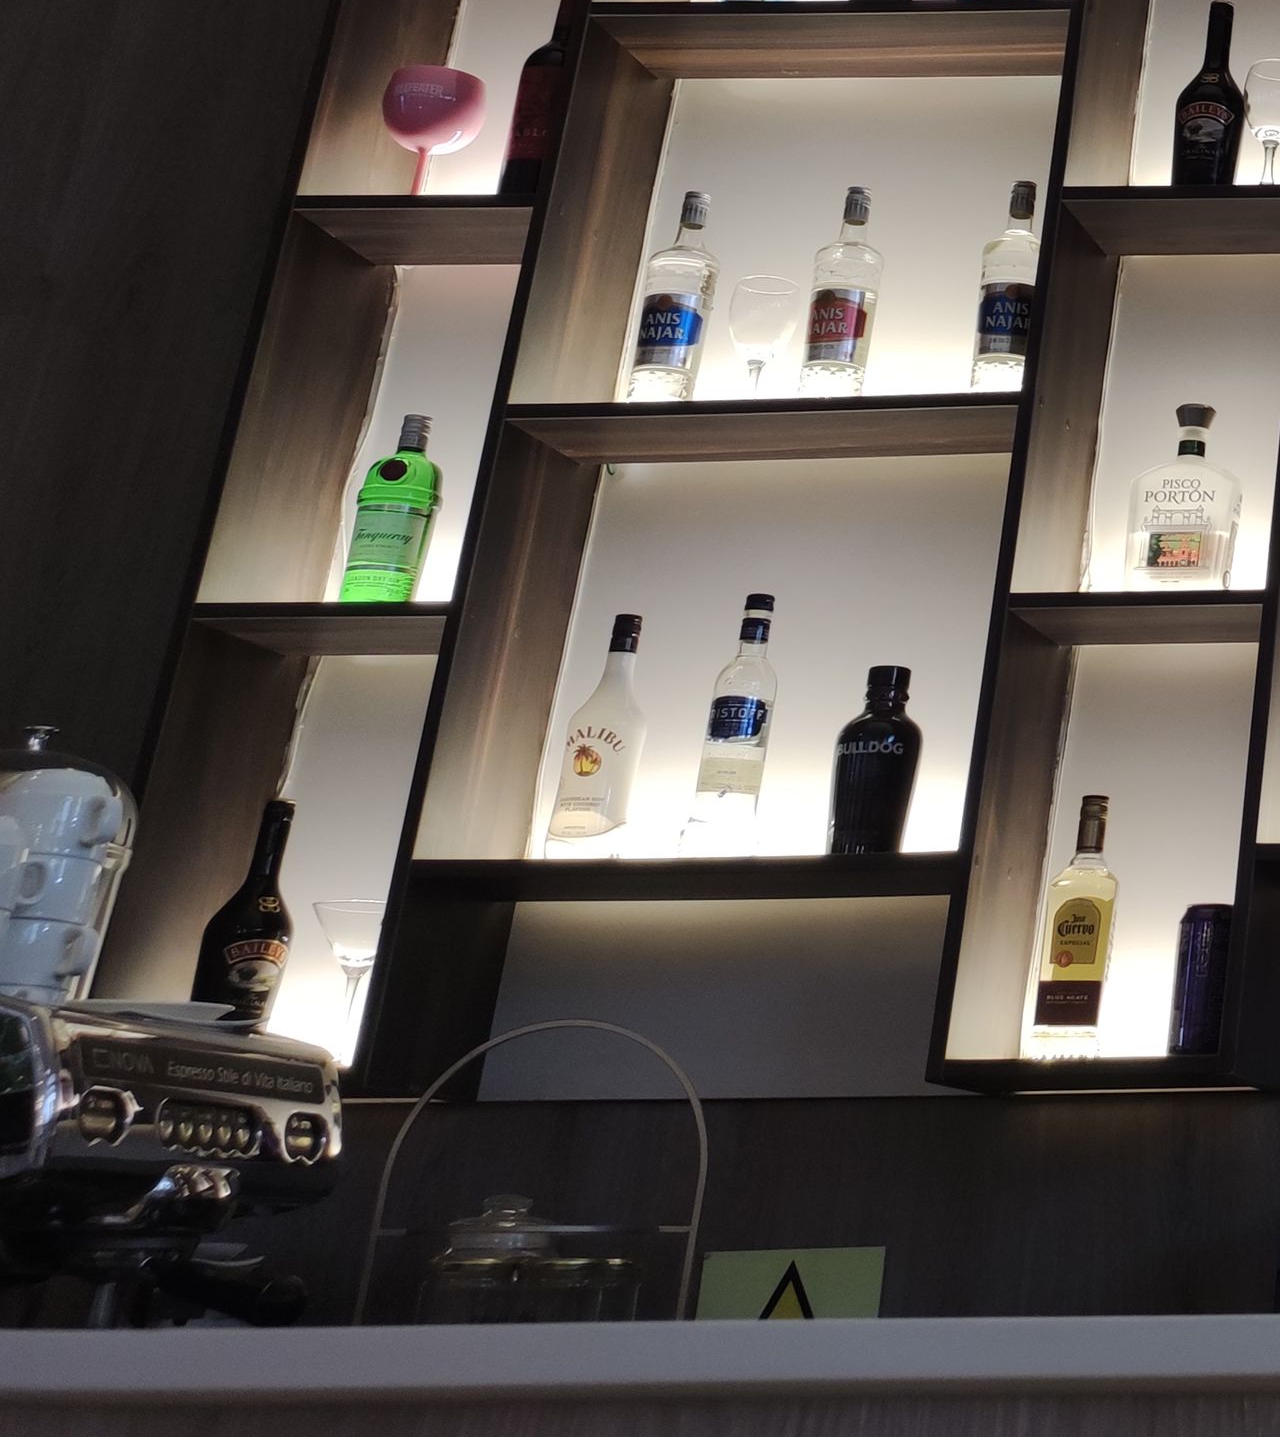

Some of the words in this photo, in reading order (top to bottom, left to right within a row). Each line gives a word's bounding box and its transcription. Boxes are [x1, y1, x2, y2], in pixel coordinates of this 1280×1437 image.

[1180, 103, 1230, 121] BAILEYS
[812, 307, 843, 320] ANIS
[993, 301, 1029, 315] ANIS
[646, 312, 681, 326] ANIS
[640, 327, 685, 341] NAJAR
[812, 321, 849, 335] AJAR
[1162, 478, 1201, 489] PISCO
[1144, 486, 1216, 503] PORTÓN
[355, 528, 413, 545] Tanqueray
[711, 707, 765, 721] RISTOFF
[567, 726, 627, 753] MALIBU
[840, 741, 904, 755] BULLDOG
[1057, 920, 1094, 937] Cuervo
[167, 1061, 215, 1082] Espresso
[242, 1070, 252, 1086] di
[255, 1072, 275, 1089] Vita
[277, 1075, 313, 1095] Italiano
